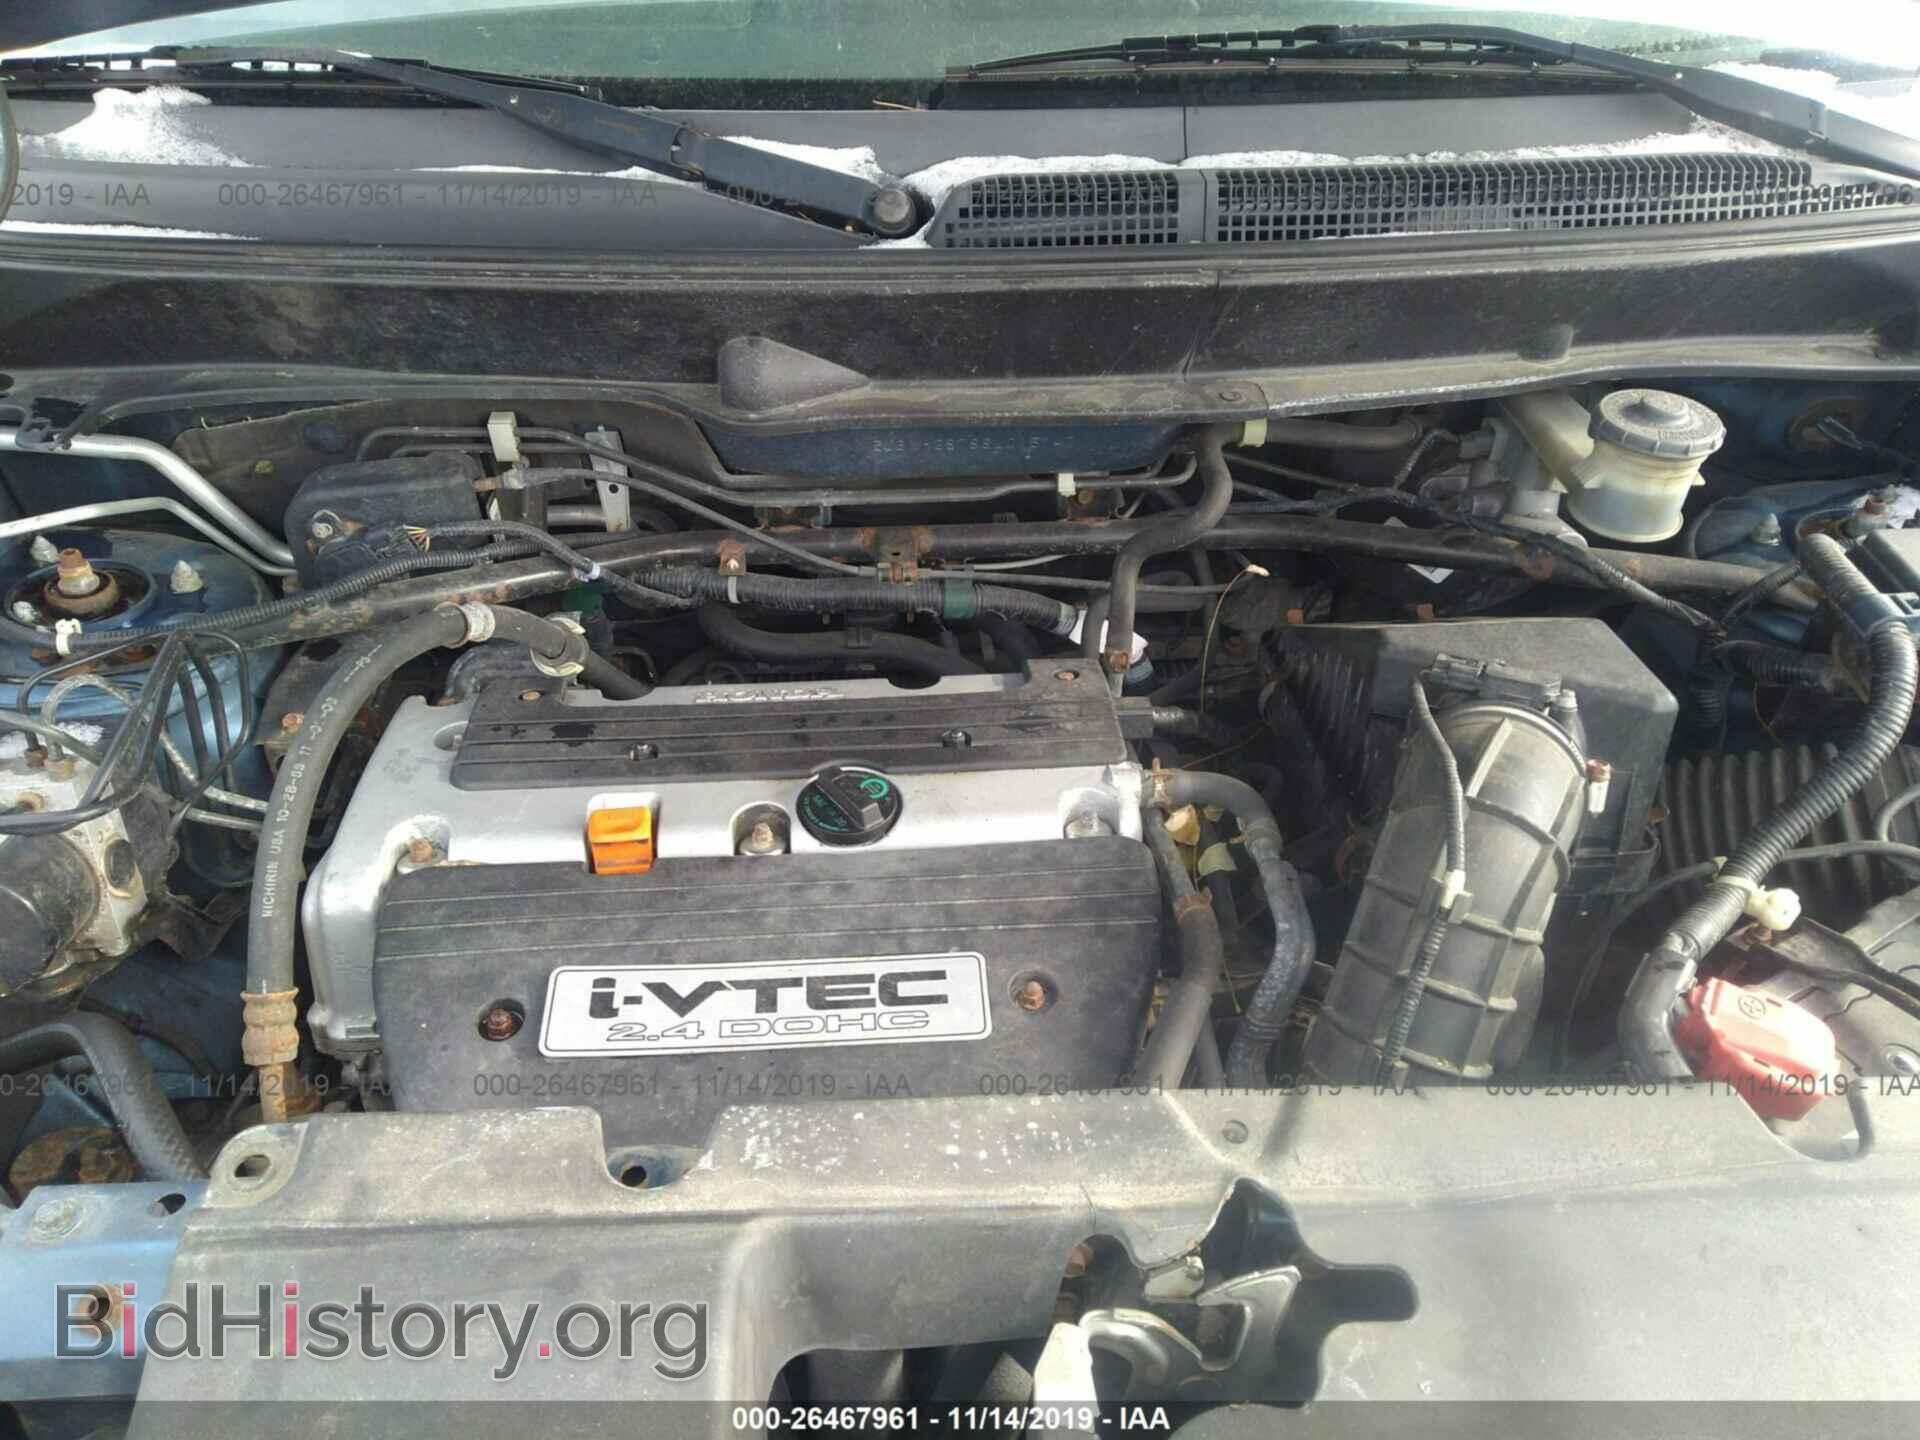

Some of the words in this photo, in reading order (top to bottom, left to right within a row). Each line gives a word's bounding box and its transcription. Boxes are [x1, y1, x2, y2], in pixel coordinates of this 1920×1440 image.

[270, 828, 286, 854] USA
[262, 859, 279, 917] NICHIRIN
[588, 970, 949, 1019] i-VTEC
[606, 1022, 705, 1042] 2.4
[719, 1010, 930, 1038] DOHC
